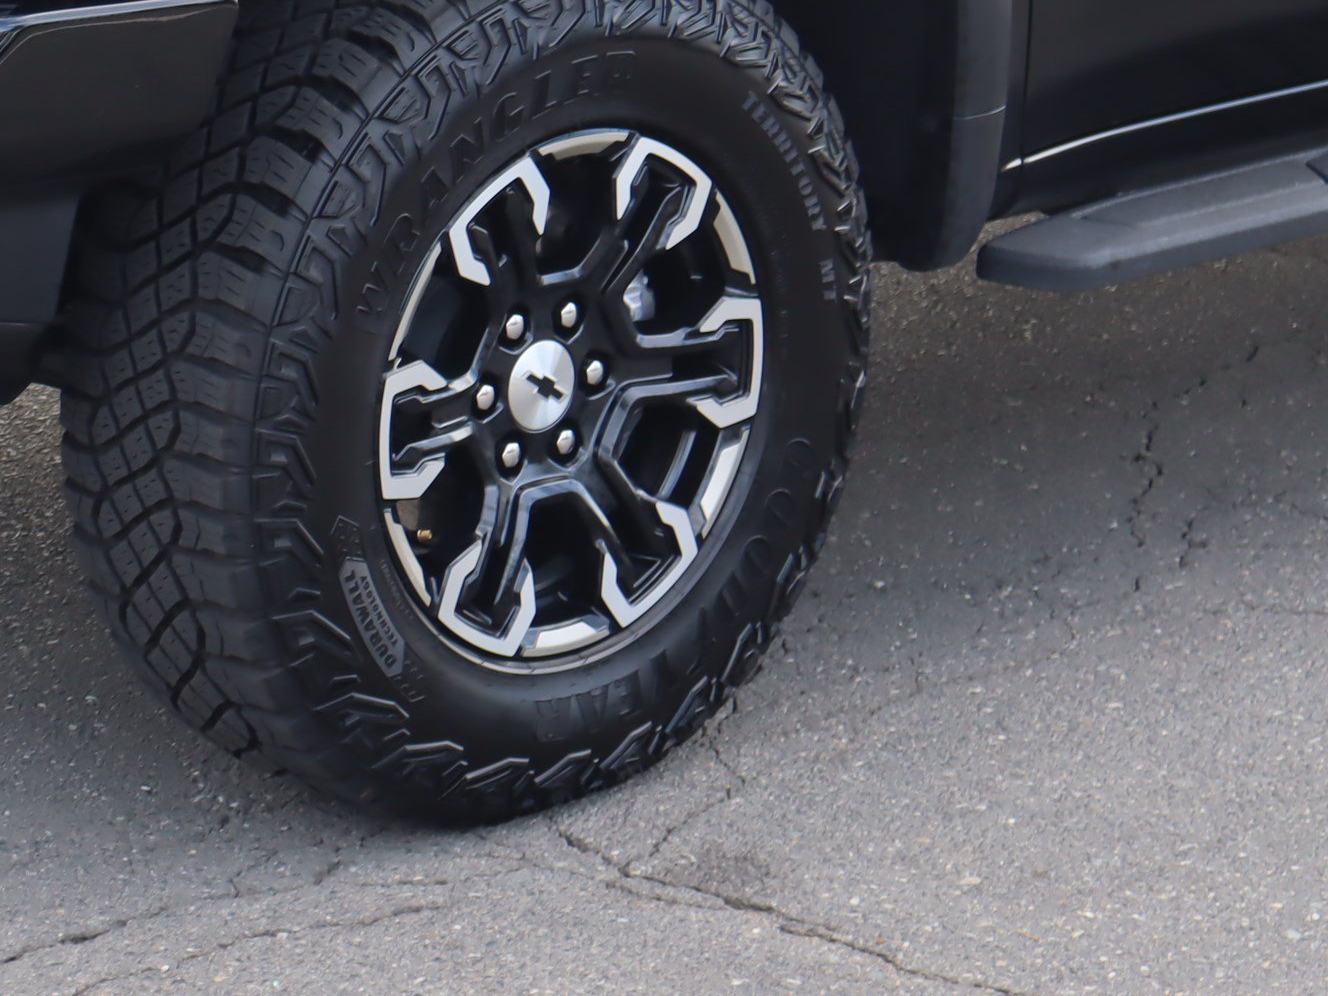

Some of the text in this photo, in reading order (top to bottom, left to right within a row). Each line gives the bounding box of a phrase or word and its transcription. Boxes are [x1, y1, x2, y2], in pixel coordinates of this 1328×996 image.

[353, 49, 636, 330] WRANGLER
[741, 91, 827, 231] TERRITORY
[344, 569, 397, 668] DURAWALL
[360, 575, 399, 648] TECHNOLOGY
